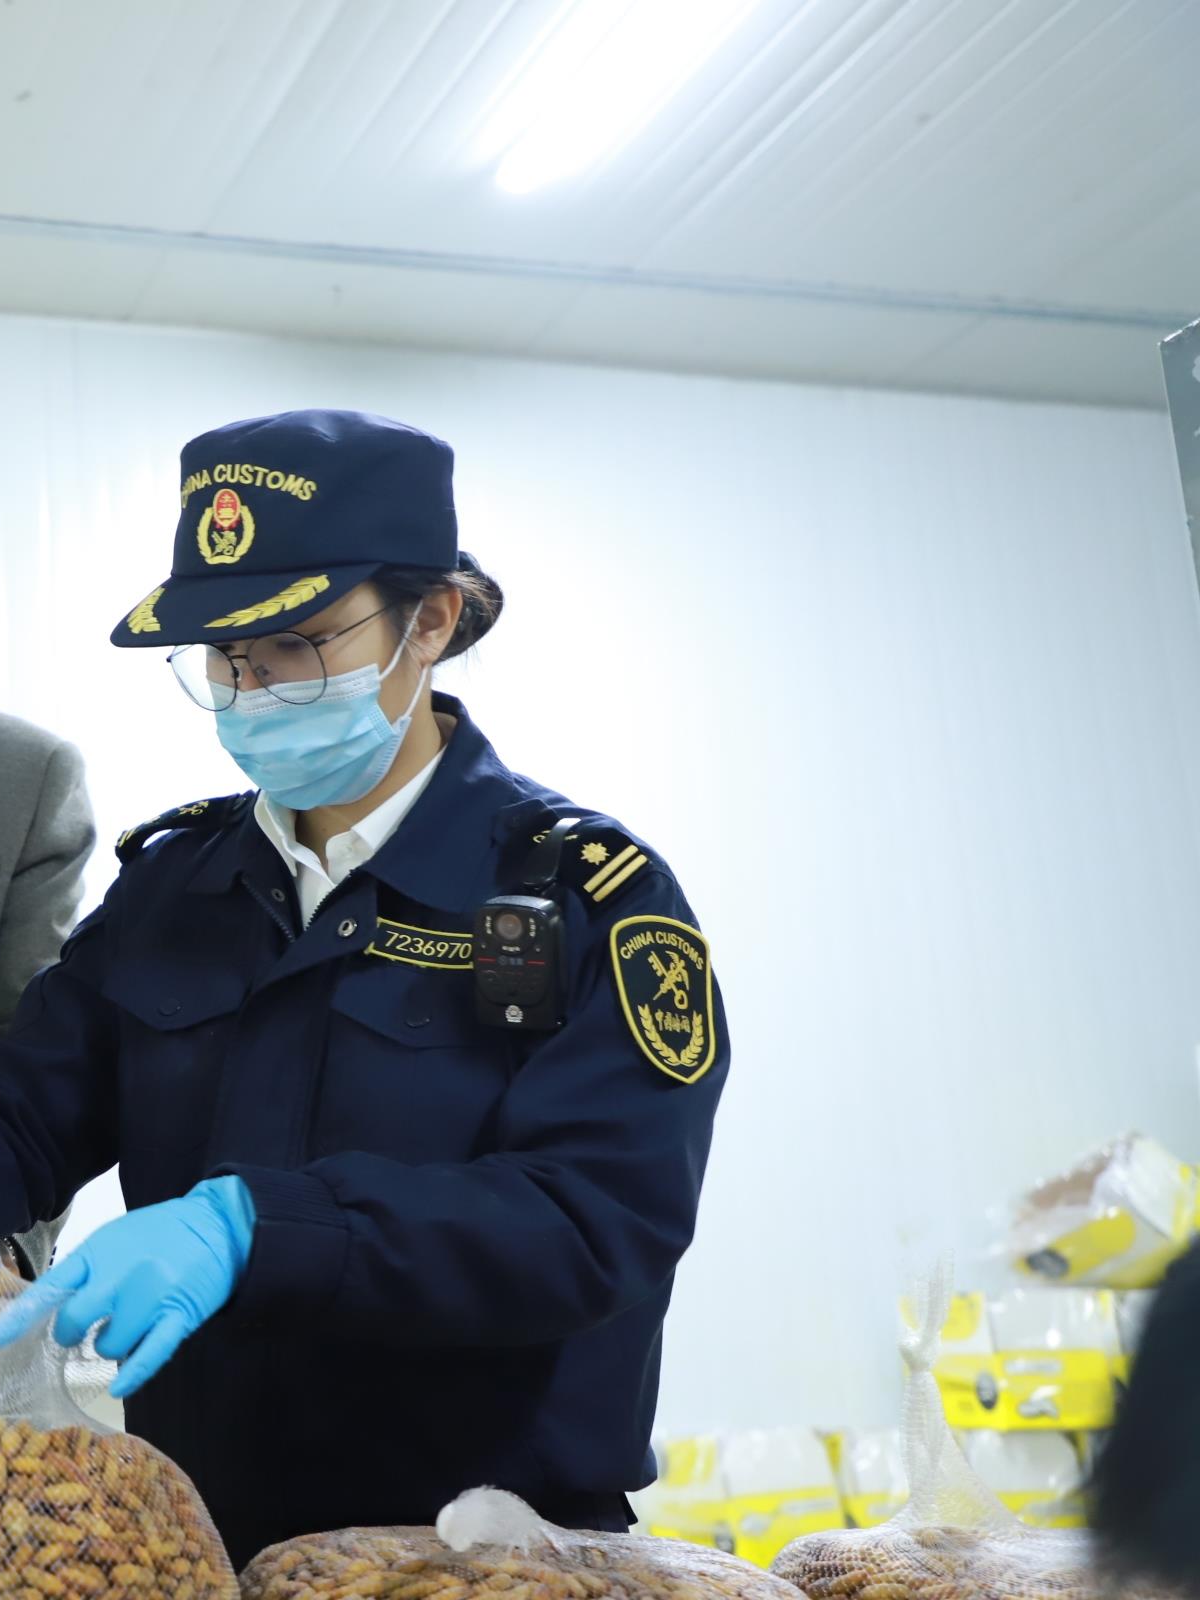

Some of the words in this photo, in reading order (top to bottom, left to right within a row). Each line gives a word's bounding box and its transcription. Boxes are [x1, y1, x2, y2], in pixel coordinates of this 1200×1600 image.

[213, 464, 317, 501] CUSTOMS
[385, 931, 472, 959] 7236970
[620, 931, 655, 960] CHINA
[656, 931, 704, 971] CUSTOMS
